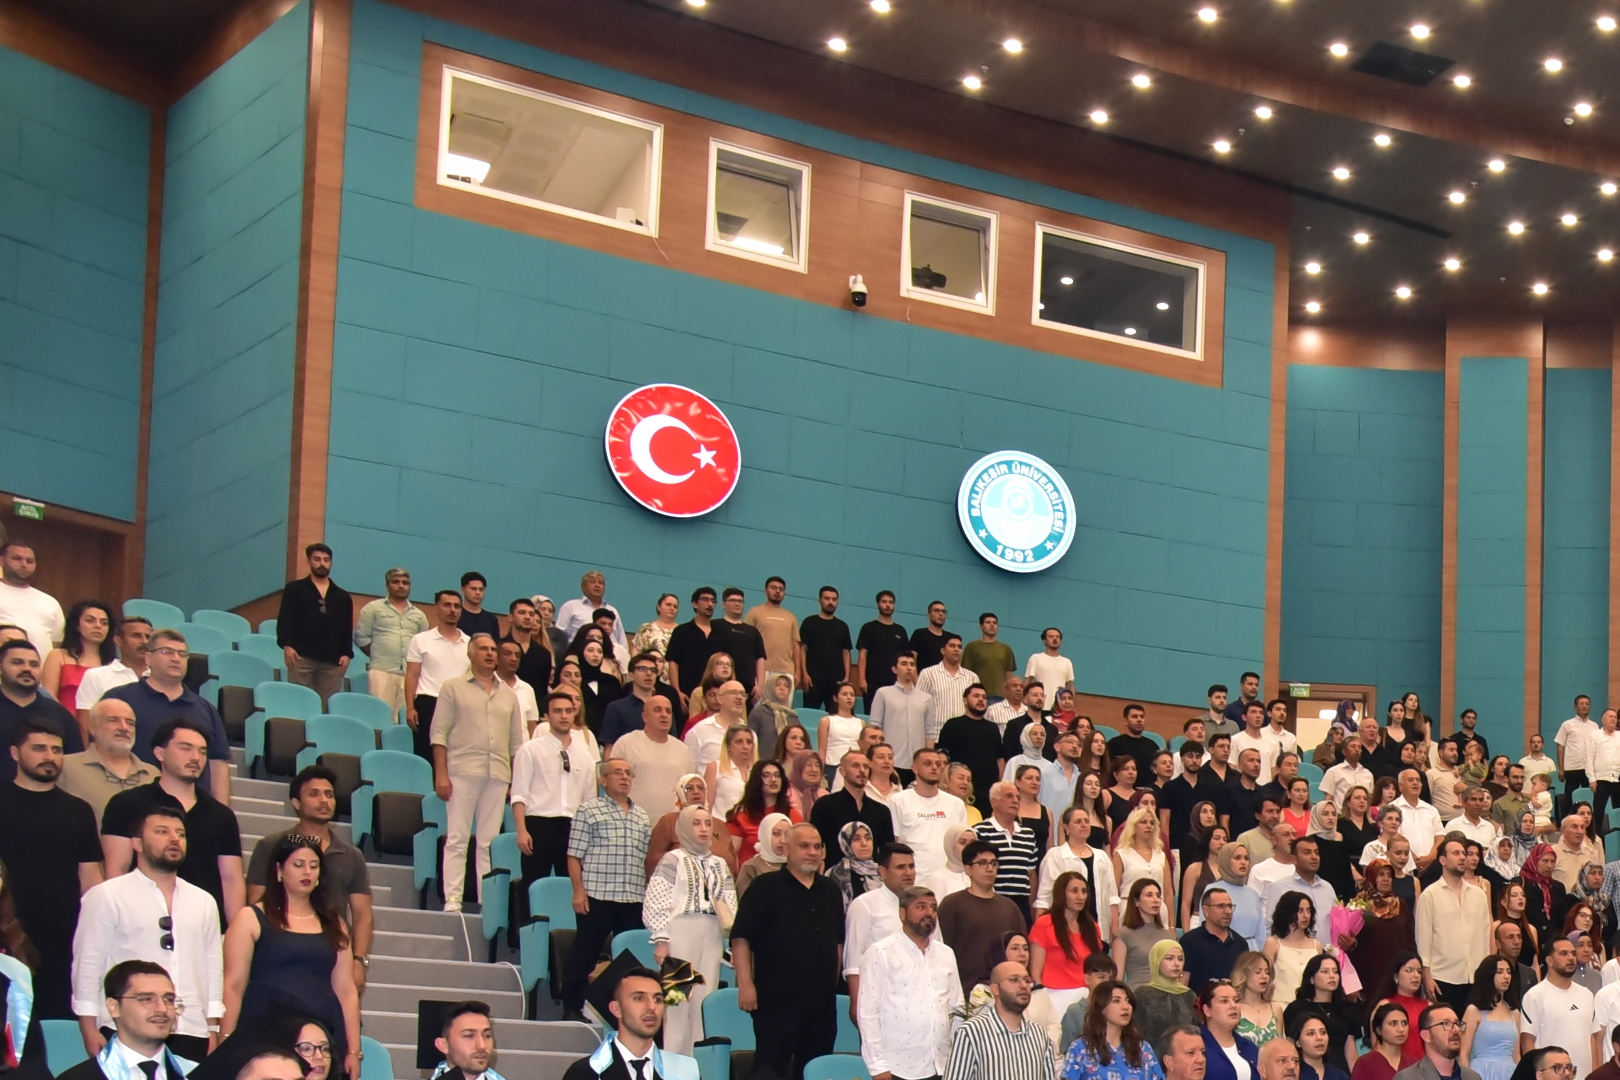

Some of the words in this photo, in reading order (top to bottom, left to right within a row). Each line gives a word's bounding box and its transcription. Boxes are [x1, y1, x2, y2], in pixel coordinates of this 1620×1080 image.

[970, 463, 1009, 517] BALIKESİR
[1011, 461, 1065, 534] ÜNİVERSİTESİ
[996, 545, 1035, 563] 1992
